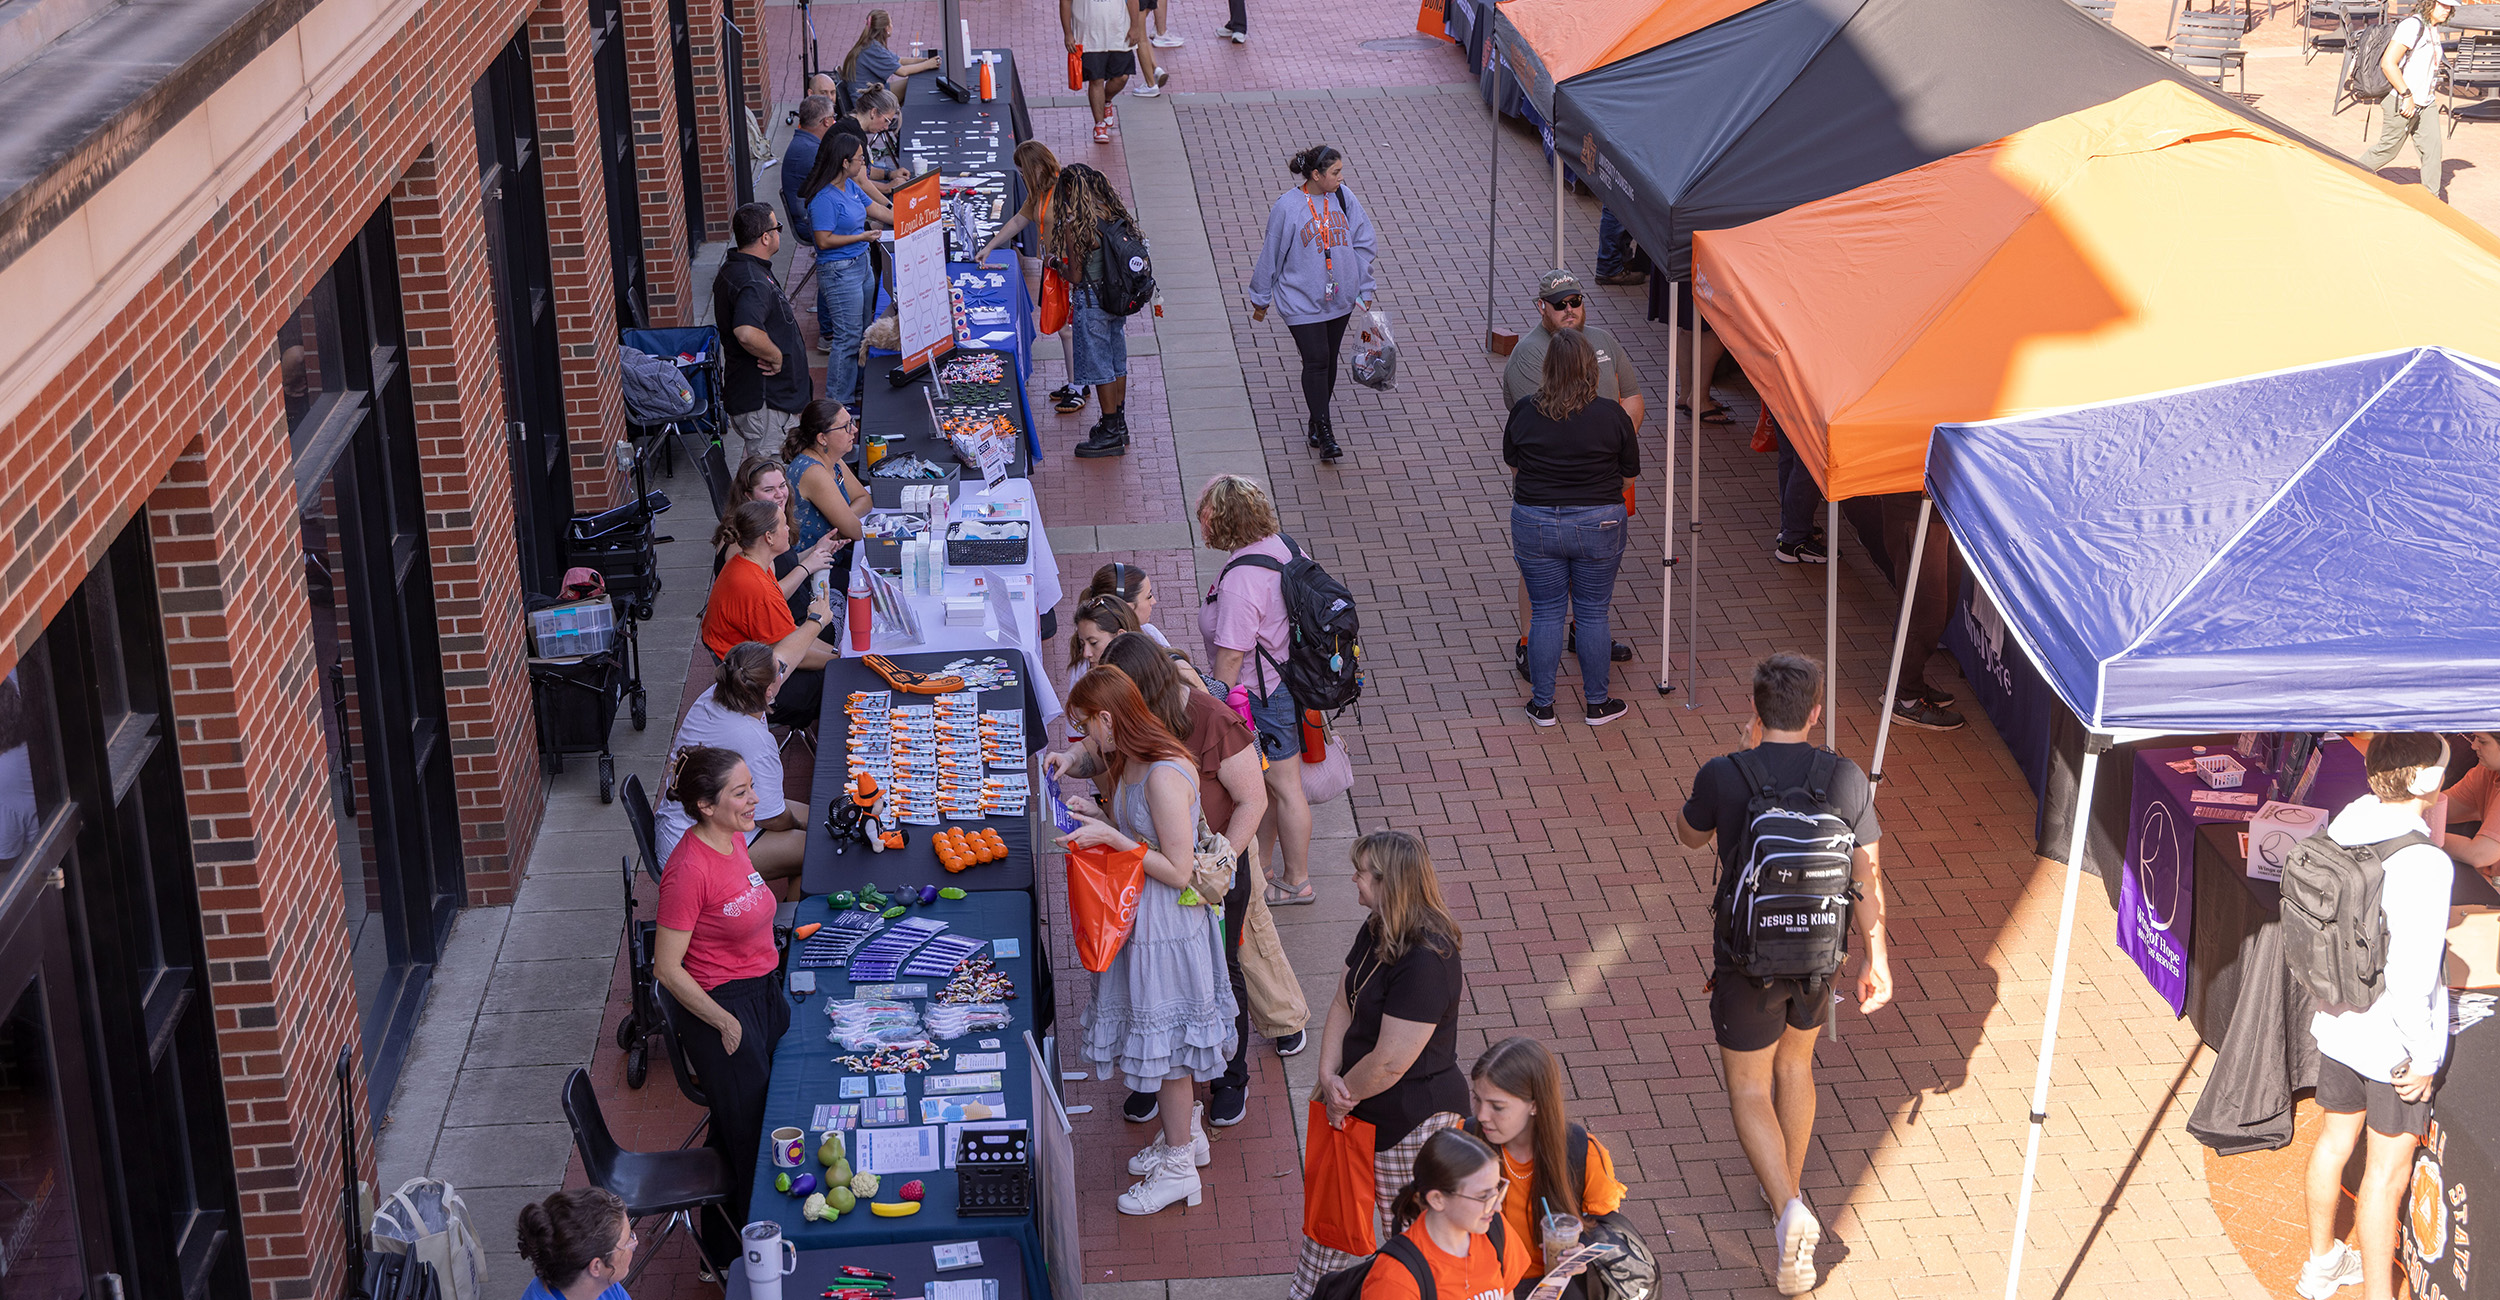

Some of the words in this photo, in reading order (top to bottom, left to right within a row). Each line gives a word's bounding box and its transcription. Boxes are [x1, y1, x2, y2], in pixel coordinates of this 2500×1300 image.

[900, 213, 918, 236] Loyal
[918, 213, 924, 226] &
[924, 207, 940, 224] True
[1315, 229, 1349, 254] SATE
[1759, 914, 1793, 928] JESUS
[1797, 913, 1808, 926] IS
[1811, 912, 1836, 926] KING
[2160, 939, 2180, 966] Hope
[2448, 1183, 2471, 1292] STATE
